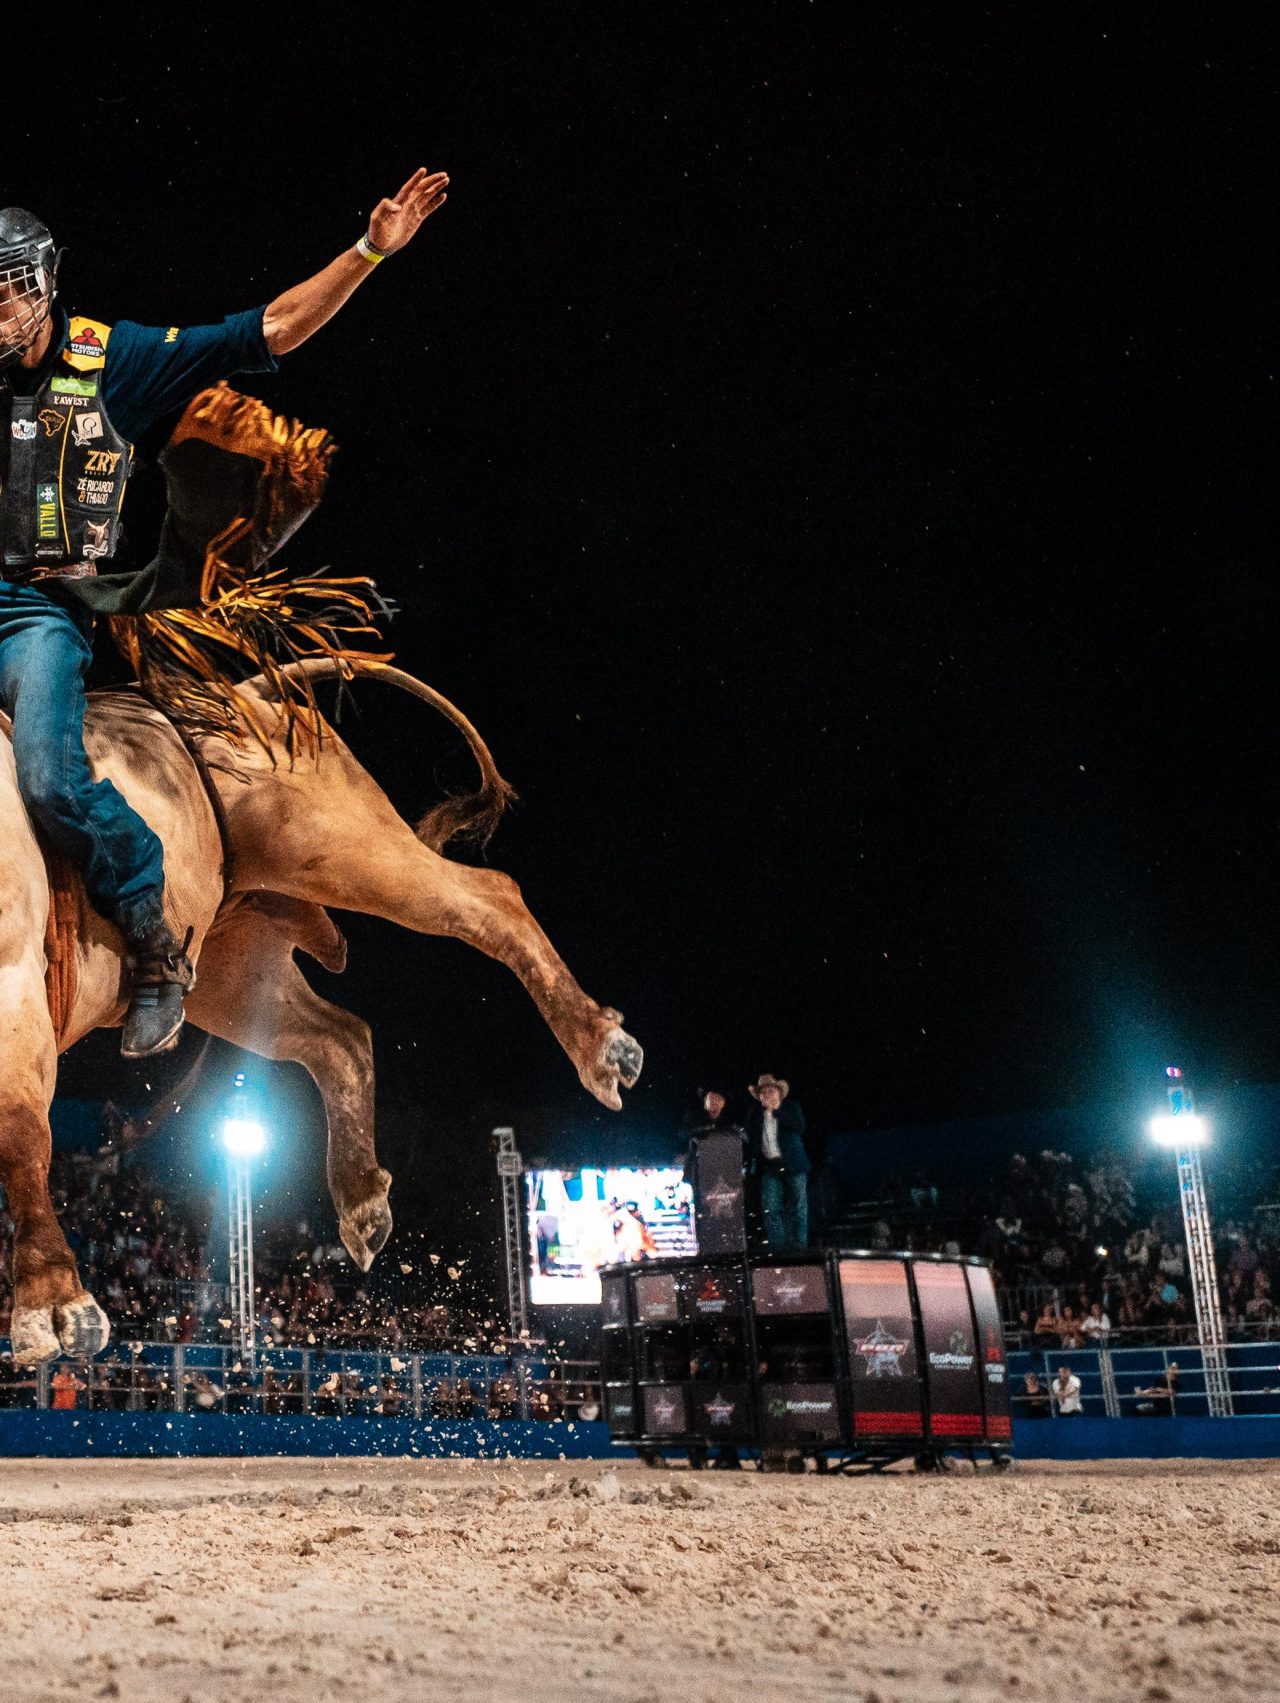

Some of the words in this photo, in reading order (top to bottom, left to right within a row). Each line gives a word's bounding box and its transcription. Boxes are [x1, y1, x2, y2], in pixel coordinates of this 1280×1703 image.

[77, 477, 87, 491] ZÉ
[86, 480, 114, 493] RICARDO
[86, 491, 109, 505] THIAGO
[929, 1352, 974, 1365] EcoPower
